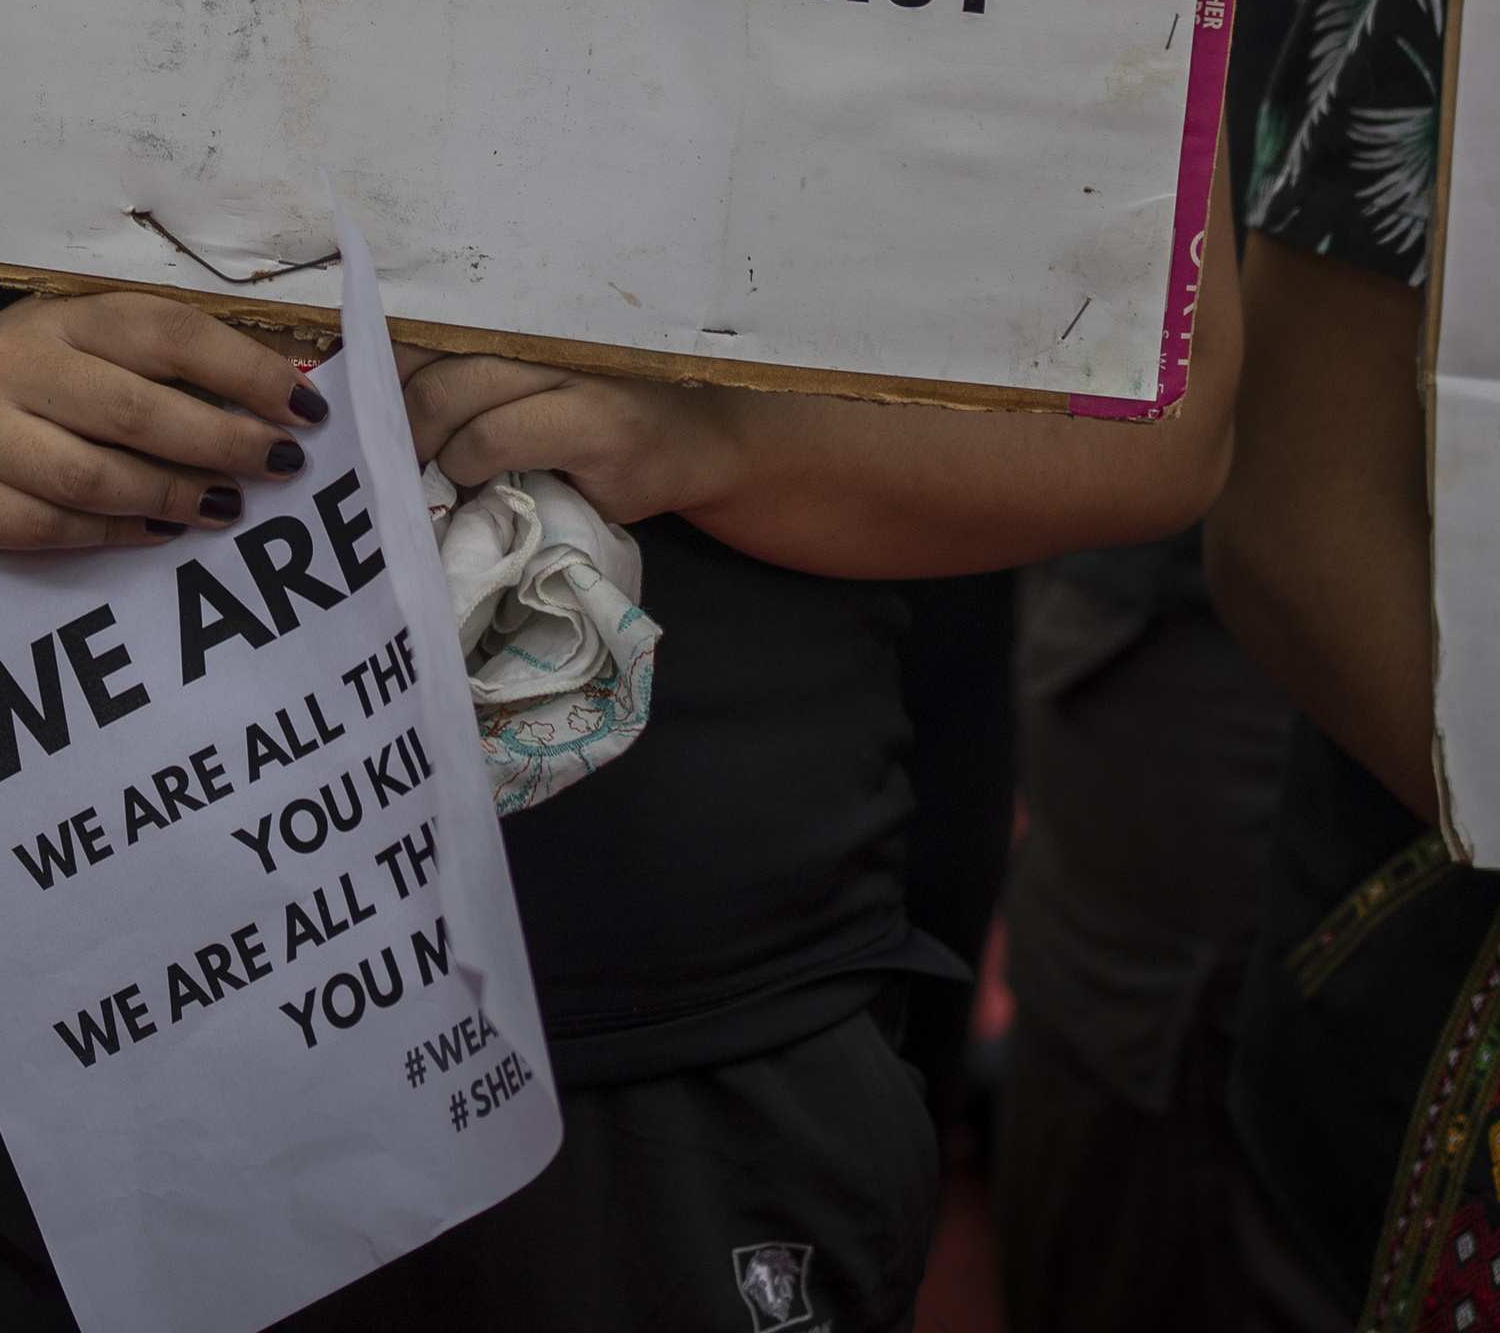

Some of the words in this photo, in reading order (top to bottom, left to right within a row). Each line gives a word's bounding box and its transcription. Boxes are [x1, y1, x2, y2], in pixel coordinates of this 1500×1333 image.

[176, 468, 386, 686] ARE
[12, 807, 114, 890] WE
[124, 744, 234, 846] ARE
[246, 693, 345, 784] ALL
[231, 772, 362, 874] YOU
[53, 983, 158, 1068] WE
[167, 923, 273, 1024] ARE
[286, 873, 376, 963] ALL
[279, 947, 403, 1049] YOU
